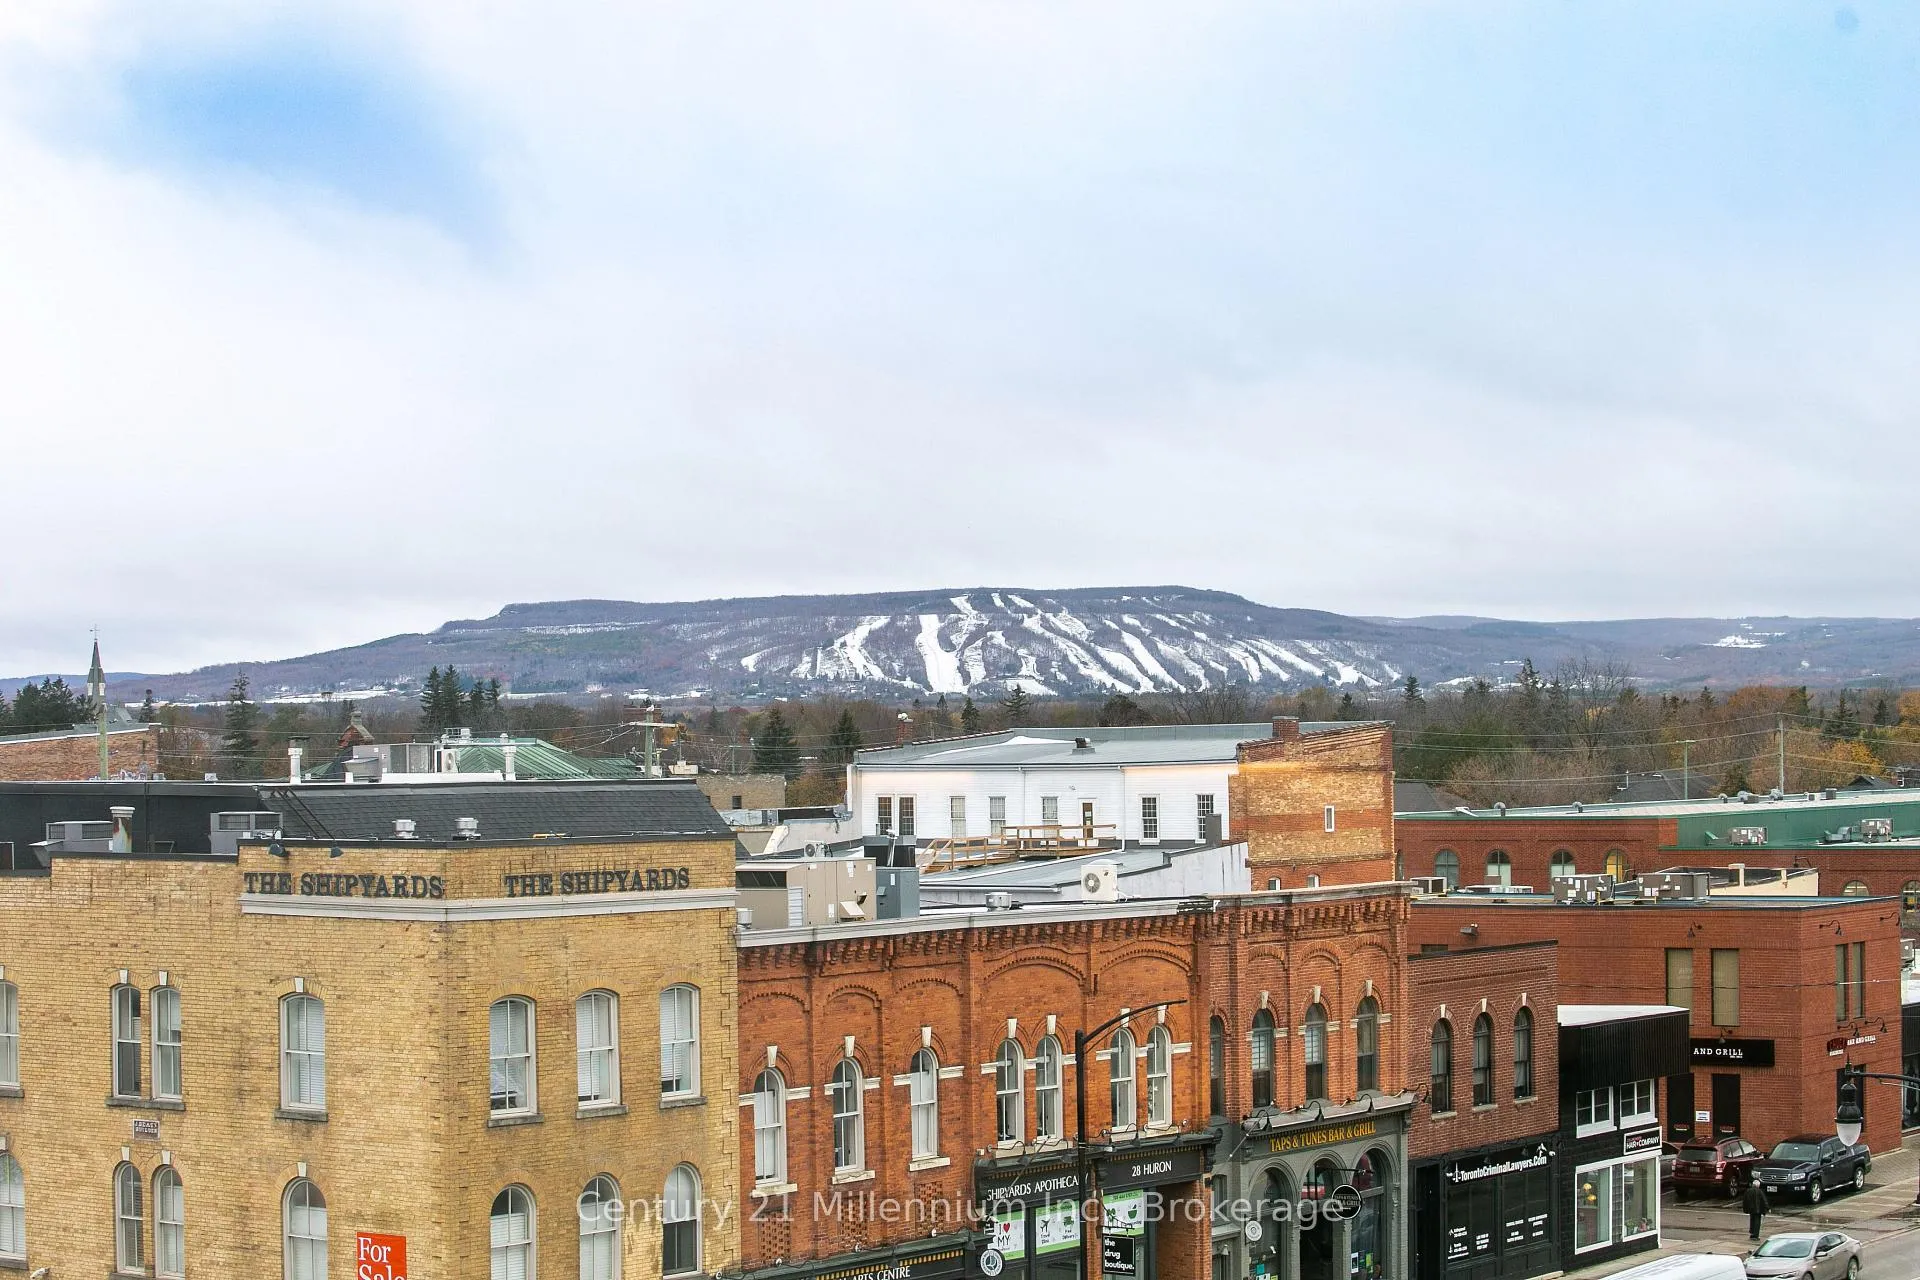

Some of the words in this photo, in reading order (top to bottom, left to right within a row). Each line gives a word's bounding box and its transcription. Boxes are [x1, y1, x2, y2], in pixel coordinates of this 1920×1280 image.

[244, 872, 292, 895] THE
[300, 872, 444, 898] SHIPYARDS
[505, 873, 553, 897] THE
[560, 867, 690, 894] SHIPYARDS
[1715, 1048, 1743, 1056] GRILL
[1270, 1135, 1291, 1152] TAPS
[1292, 1136, 1299, 1149] &
[1300, 1129, 1327, 1147] TUNES
[1328, 1127, 1345, 1142] BAR
[1346, 1126, 1353, 1139] &
[1353, 1121, 1377, 1137] GRILL
[1131, 1165, 1141, 1177] 28
[1143, 1160, 1172, 1175] HURON
[987, 1182, 1031, 1201] SHIPYARDS
[997, 1234, 1011, 1247] MY
[1104, 1238, 1116, 1247] the
[358, 1236, 392, 1263] For
[1104, 1248, 1121, 1260] drug
[358, 1263, 407, 1280] Sl
[876, 1265, 911, 1280] CENTRE
[1104, 1259, 1135, 1271] boutique.
